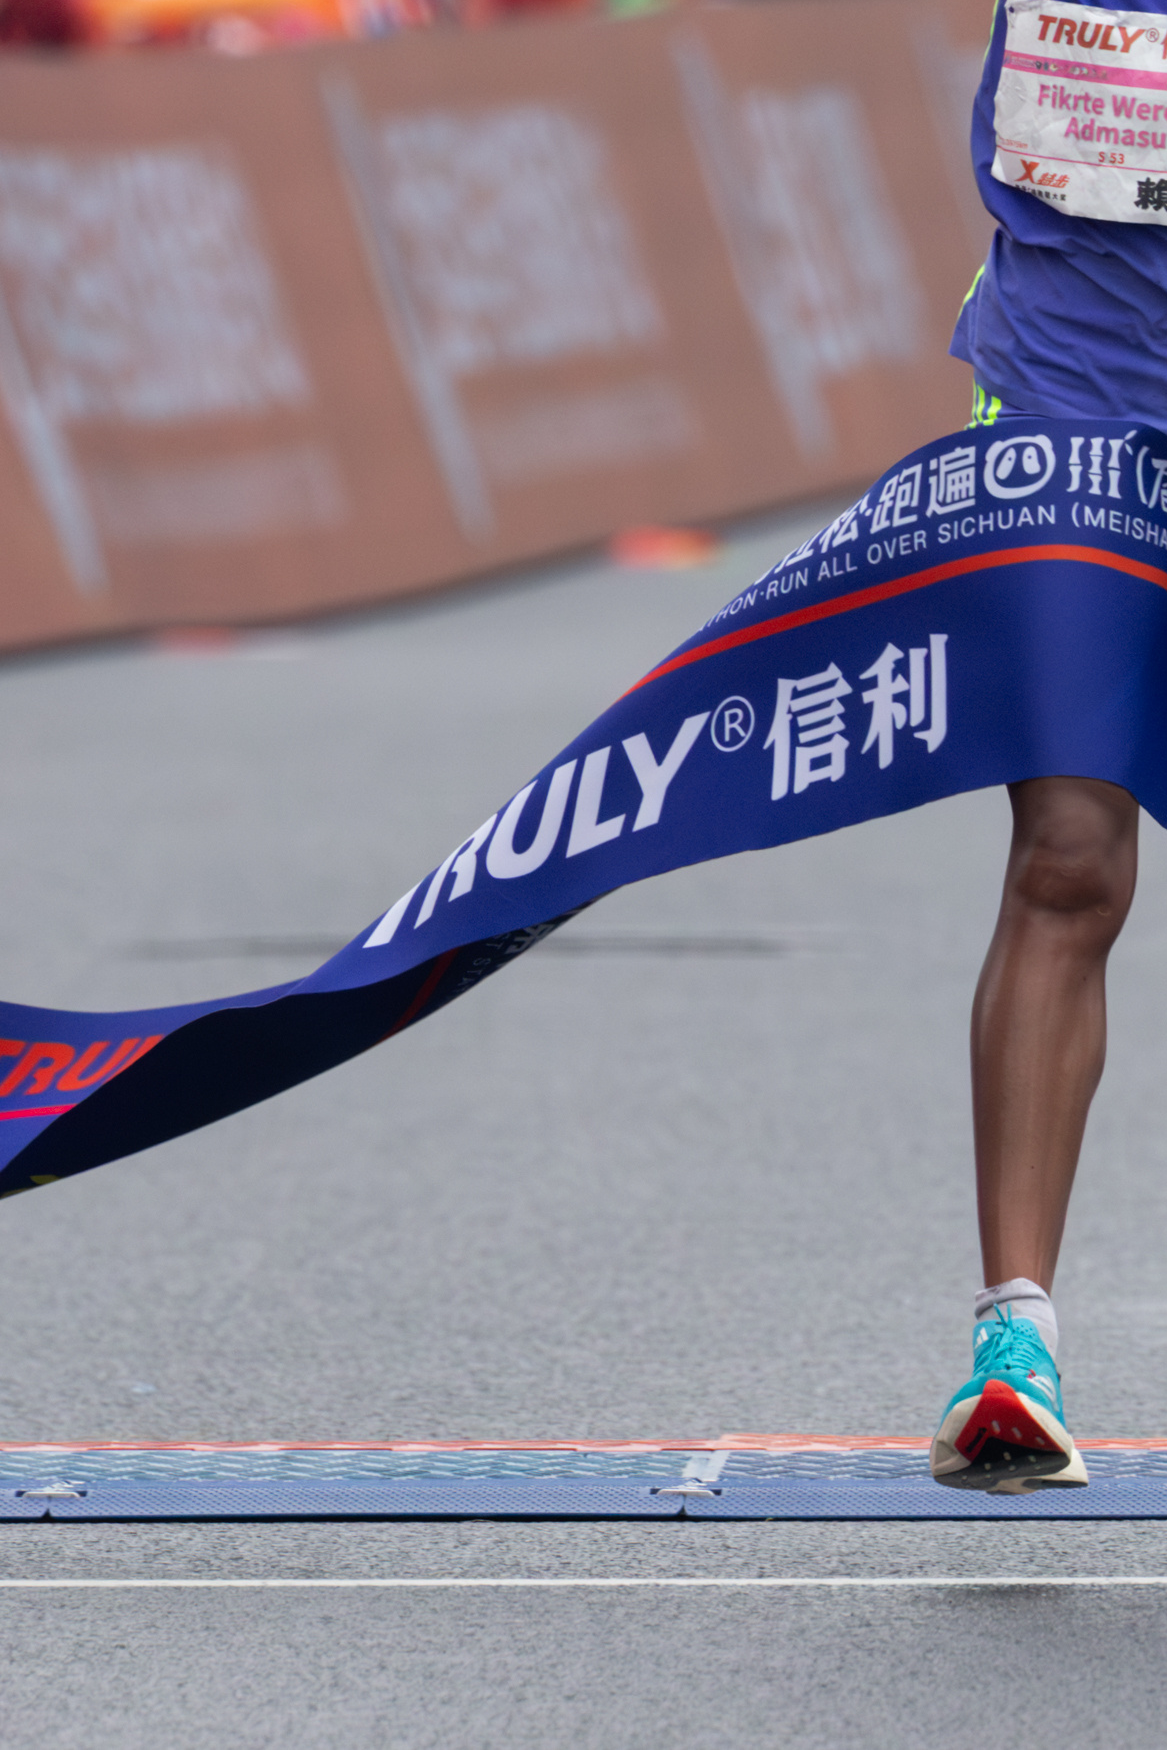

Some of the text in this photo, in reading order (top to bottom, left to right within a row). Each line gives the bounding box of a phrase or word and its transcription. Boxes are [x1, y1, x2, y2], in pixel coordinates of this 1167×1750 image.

[1037, 83, 1106, 116] Fikrte
[1064, 116, 1167, 150] Admasu
[1109, 152, 1126, 166] 53
[817, 552, 858, 582] ALL
[866, 529, 928, 565] OVER
[937, 504, 1056, 544] SICHUAN
[763, 633, 949, 801] 信利
